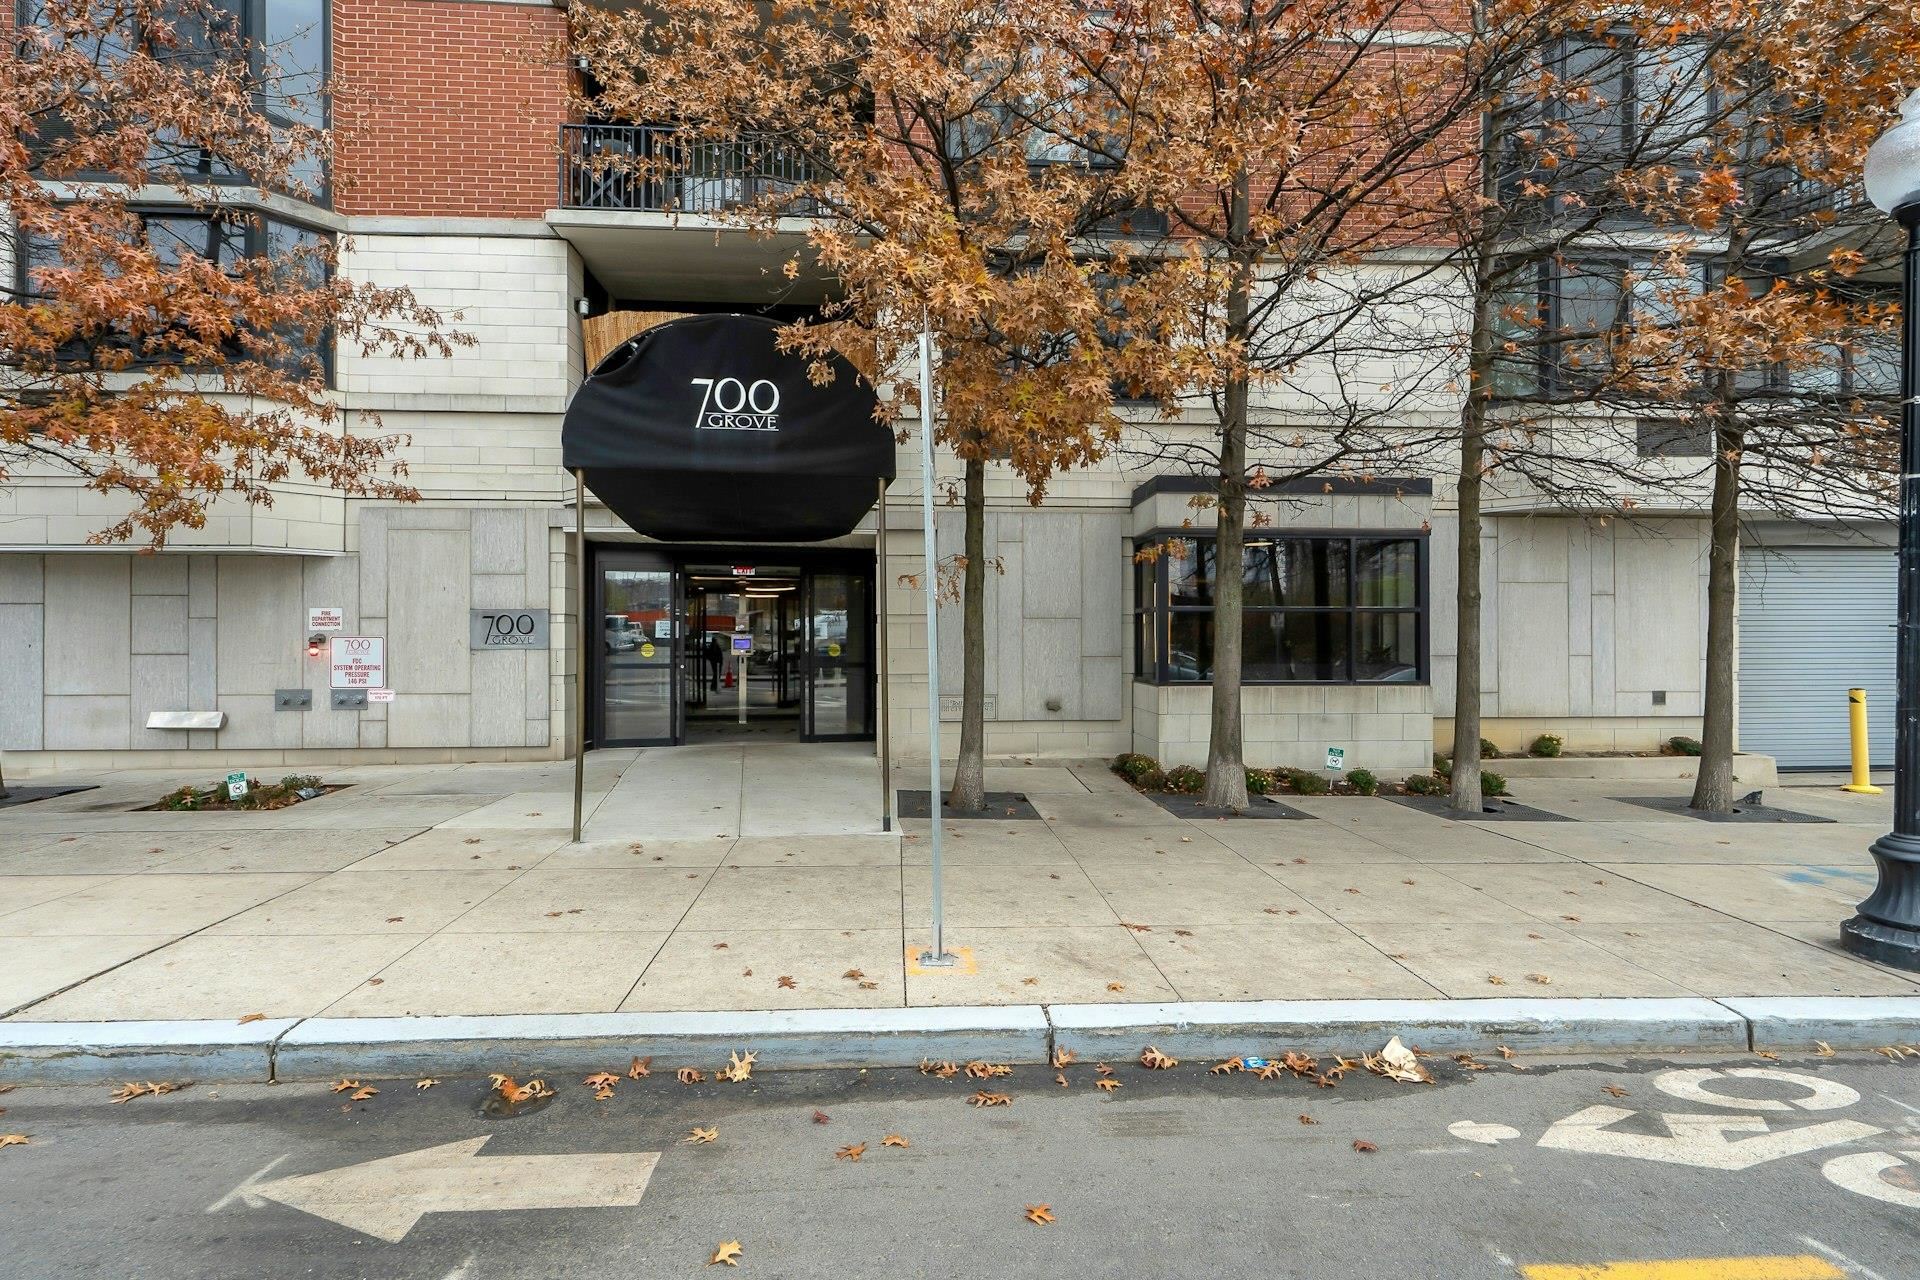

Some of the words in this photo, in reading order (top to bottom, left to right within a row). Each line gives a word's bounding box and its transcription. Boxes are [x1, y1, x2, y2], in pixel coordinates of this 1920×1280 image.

[690, 377, 780, 429] 700
[708, 415, 777, 429] GROVE
[482, 614, 535, 645] 700
[344, 639, 371, 655] 700
[492, 636, 534, 645] GROVE
